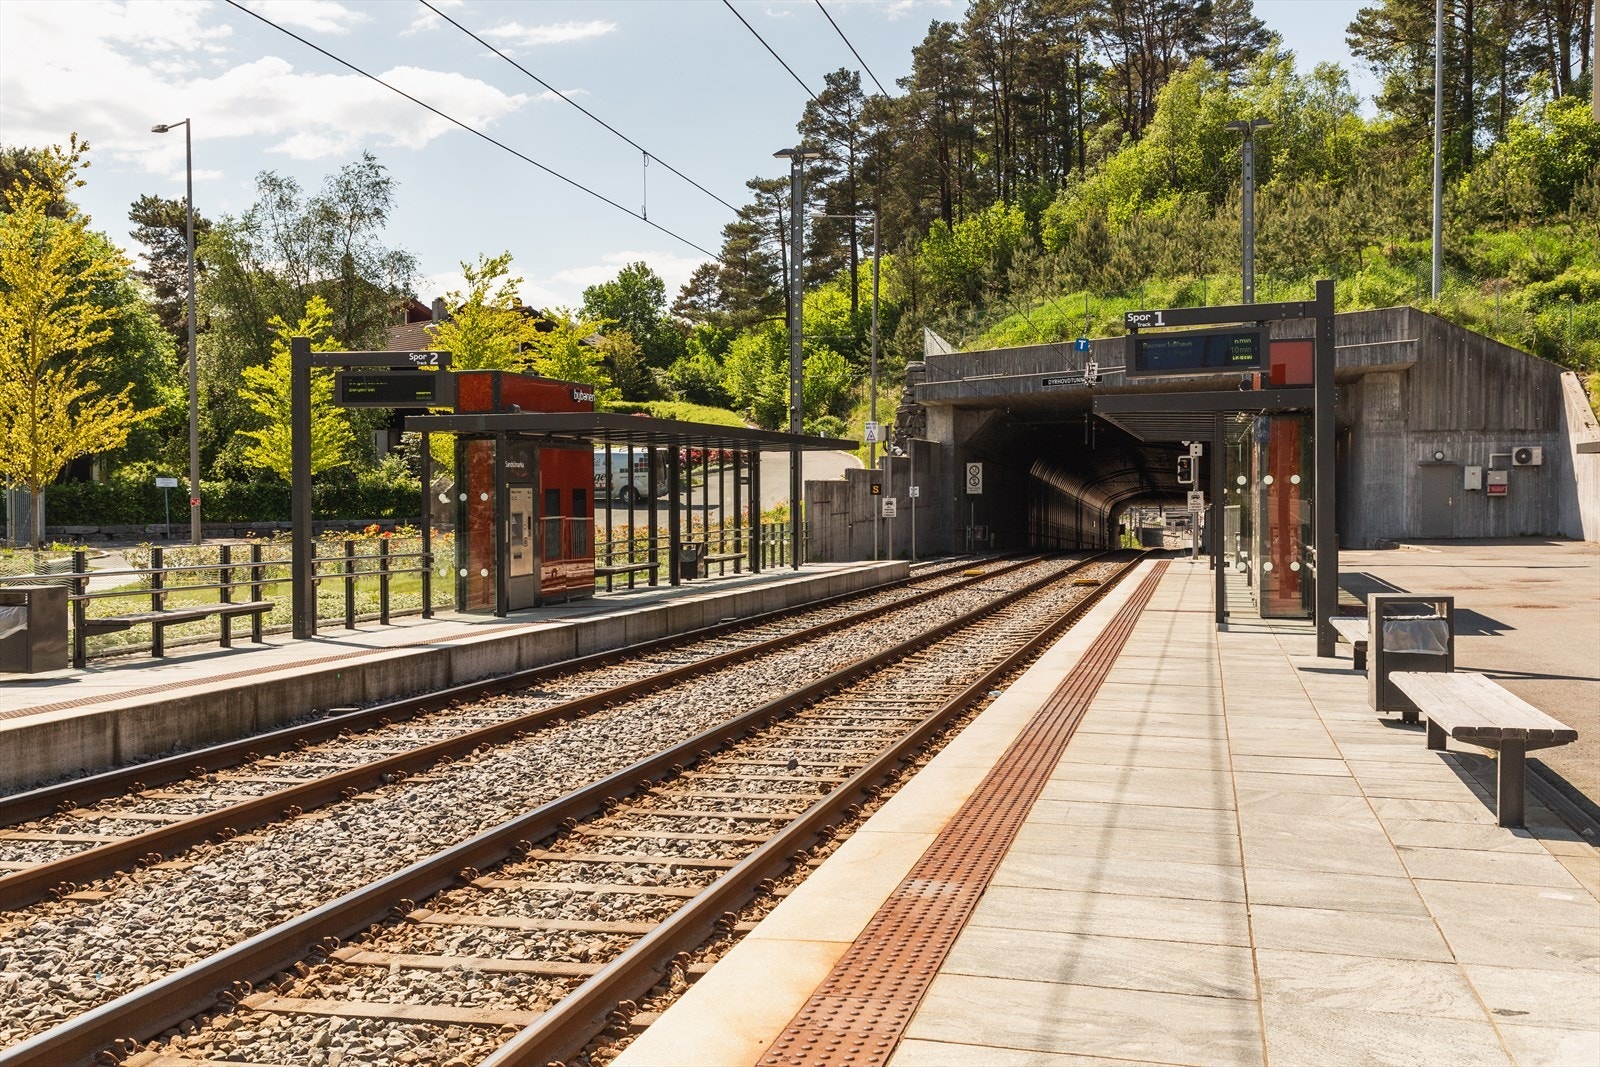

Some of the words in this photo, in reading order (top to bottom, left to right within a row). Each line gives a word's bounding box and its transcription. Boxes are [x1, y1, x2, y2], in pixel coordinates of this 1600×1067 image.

[1127, 313, 1151, 323] Spor
[1154, 311, 1165, 326] 1
[1078, 340, 1087, 350] T
[409, 353, 427, 362] Spor
[430, 352, 439, 365] 2
[573, 389, 595, 402] bybanen
[872, 485, 879, 494] S
